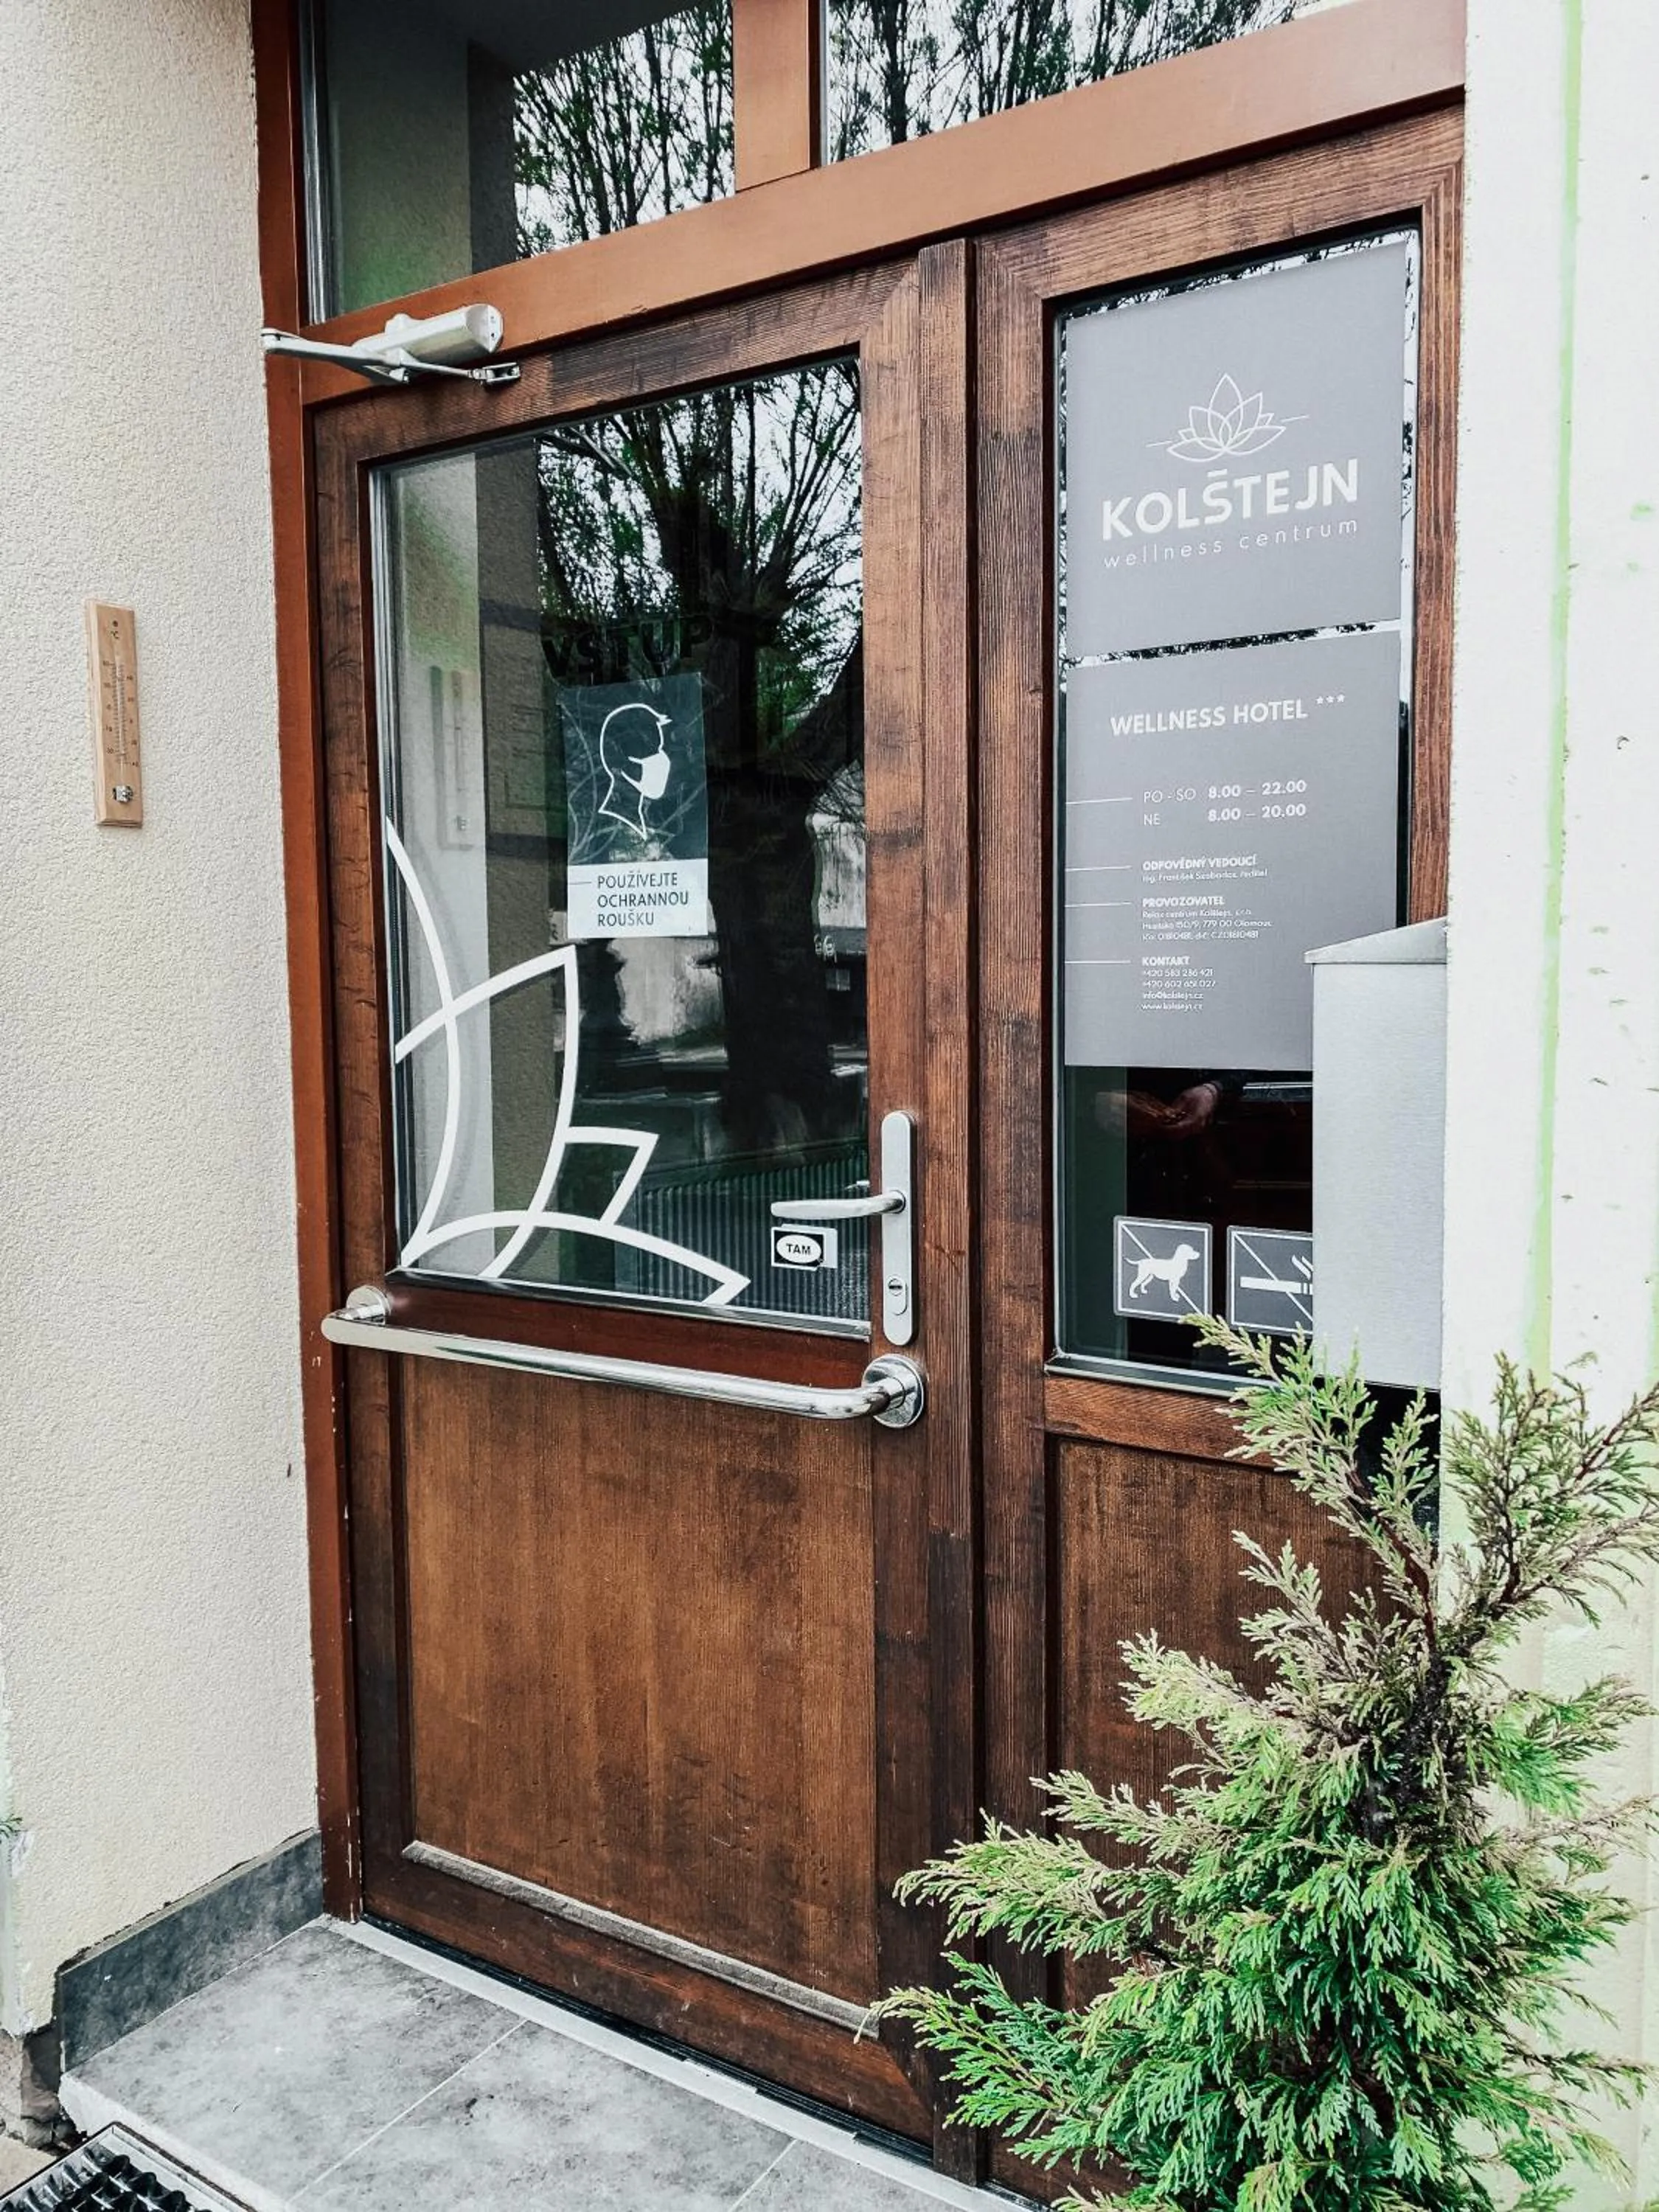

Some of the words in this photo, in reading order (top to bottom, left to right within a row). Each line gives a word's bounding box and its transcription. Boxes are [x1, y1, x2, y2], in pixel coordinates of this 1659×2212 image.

[1104, 540, 1222, 568] wellness
[1239, 518, 1357, 548] centrum
[1110, 706, 1226, 736] WELLNESS
[1234, 698, 1308, 725] HOTEL
[1144, 789, 1163, 803] PO
[1176, 787, 1196, 802] SO
[1208, 785, 1241, 799] 8.00
[1262, 779, 1307, 796] 22.00
[1144, 813, 1161, 826] NE
[1208, 807, 1241, 822] 8.00
[1262, 803, 1307, 818] 20.00
[597, 869, 678, 888] POUŽÍVEJTE
[597, 891, 689, 908] OCHRANNOU
[1143, 896, 1225, 908] PROVOZOVATEL
[598, 908, 654, 927] ROUŠKU
[1142, 956, 1191, 966] KONTAKT
[786, 1243, 811, 1254] TAM
